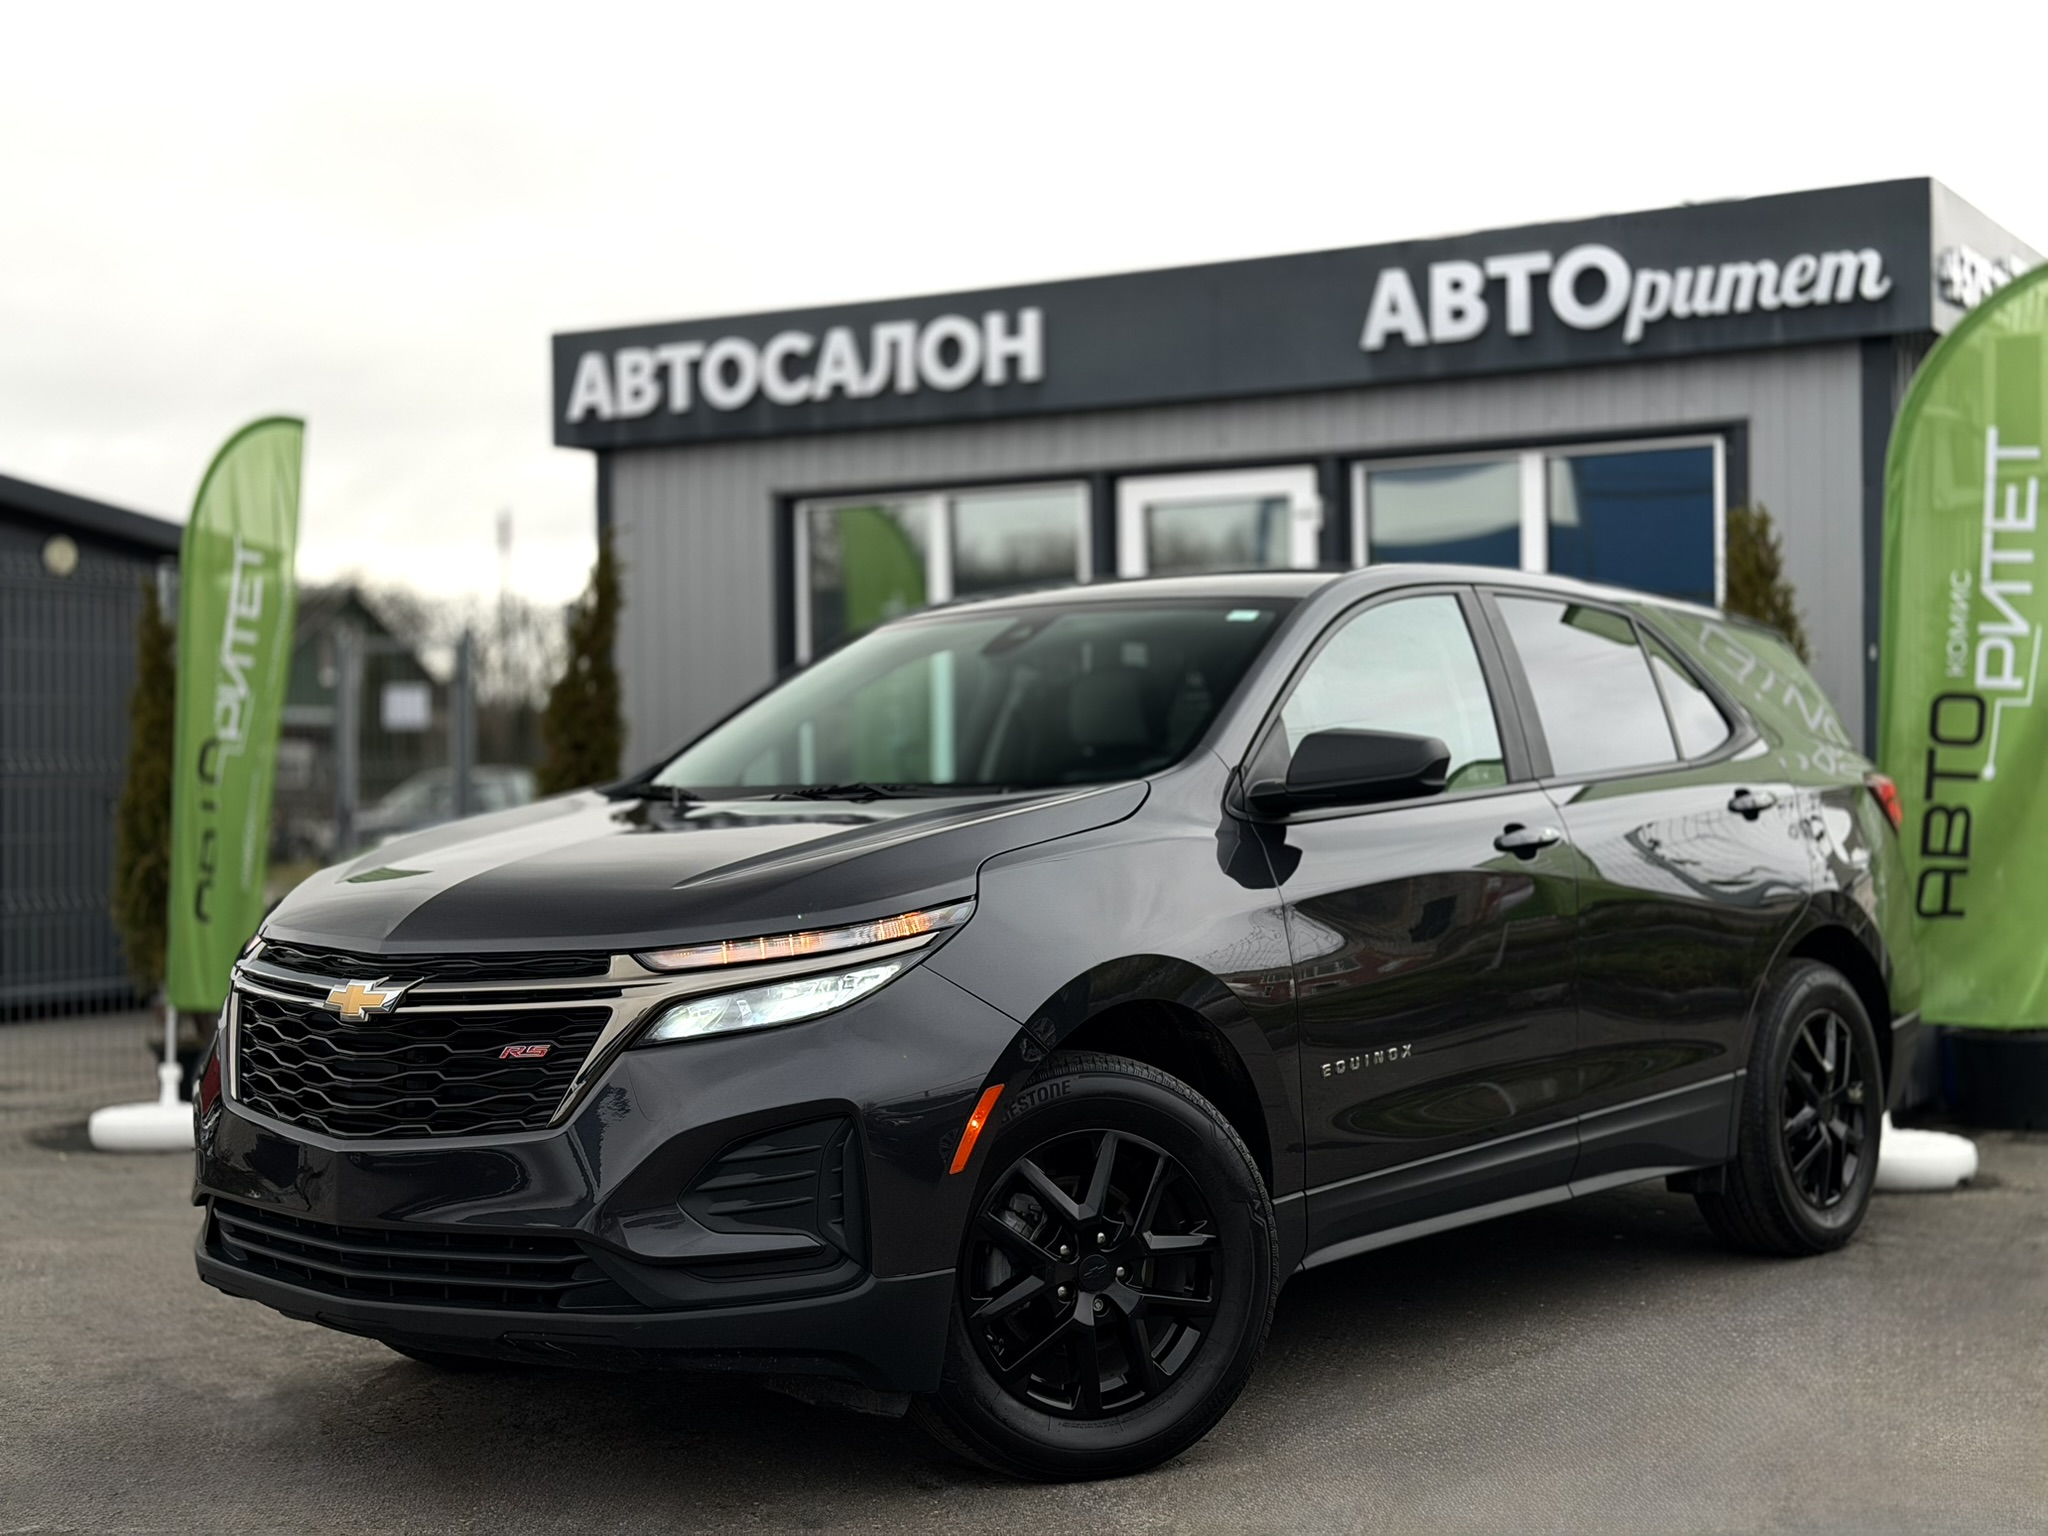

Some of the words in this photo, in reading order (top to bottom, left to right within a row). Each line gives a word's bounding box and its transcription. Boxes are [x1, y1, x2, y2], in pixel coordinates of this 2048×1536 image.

[1359, 243, 1892, 351] АВТОритет
[566, 307, 1044, 423] АВТОСАЛОН
[1975, 425, 2041, 690] РИТЕТ
[1916, 691, 1988, 920] АВТО
[499, 1044, 552, 1059] RS
[1004, 1079, 1072, 1121] ESTONE
[1321, 1043, 1412, 1078] EQUINOX
